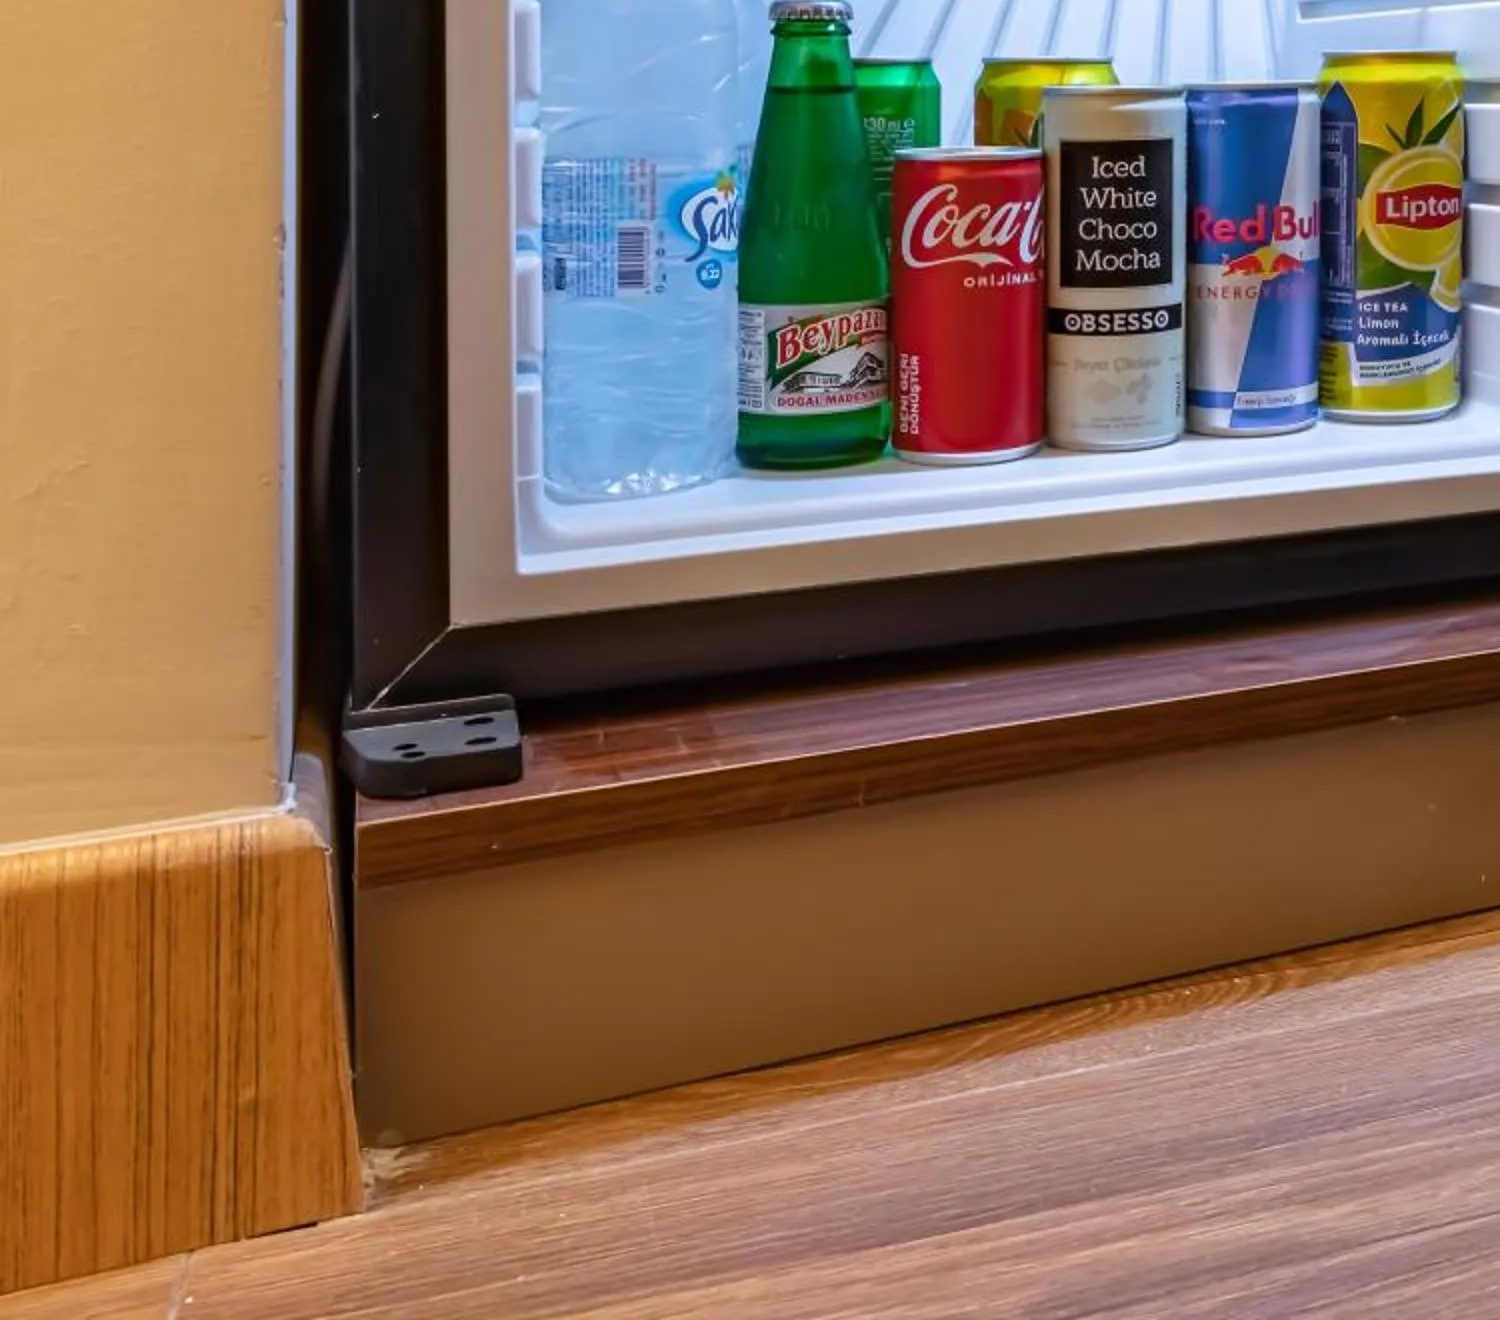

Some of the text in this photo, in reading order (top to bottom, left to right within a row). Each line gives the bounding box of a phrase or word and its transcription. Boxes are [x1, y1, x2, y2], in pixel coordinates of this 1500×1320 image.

[1091, 155, 1147, 179] Iced
[1080, 186, 1157, 209] White
[1386, 196, 1460, 223] Lipton
[684, 195, 738, 263] Sak
[1079, 217, 1158, 241] Choco
[1193, 200, 1319, 244] Red Bul
[1075, 247, 1161, 272] Mocha
[1359, 301, 1409, 313] ICE TEA
[1064, 309, 1169, 333] OBSESSO
[1359, 317, 1400, 329] Limon
